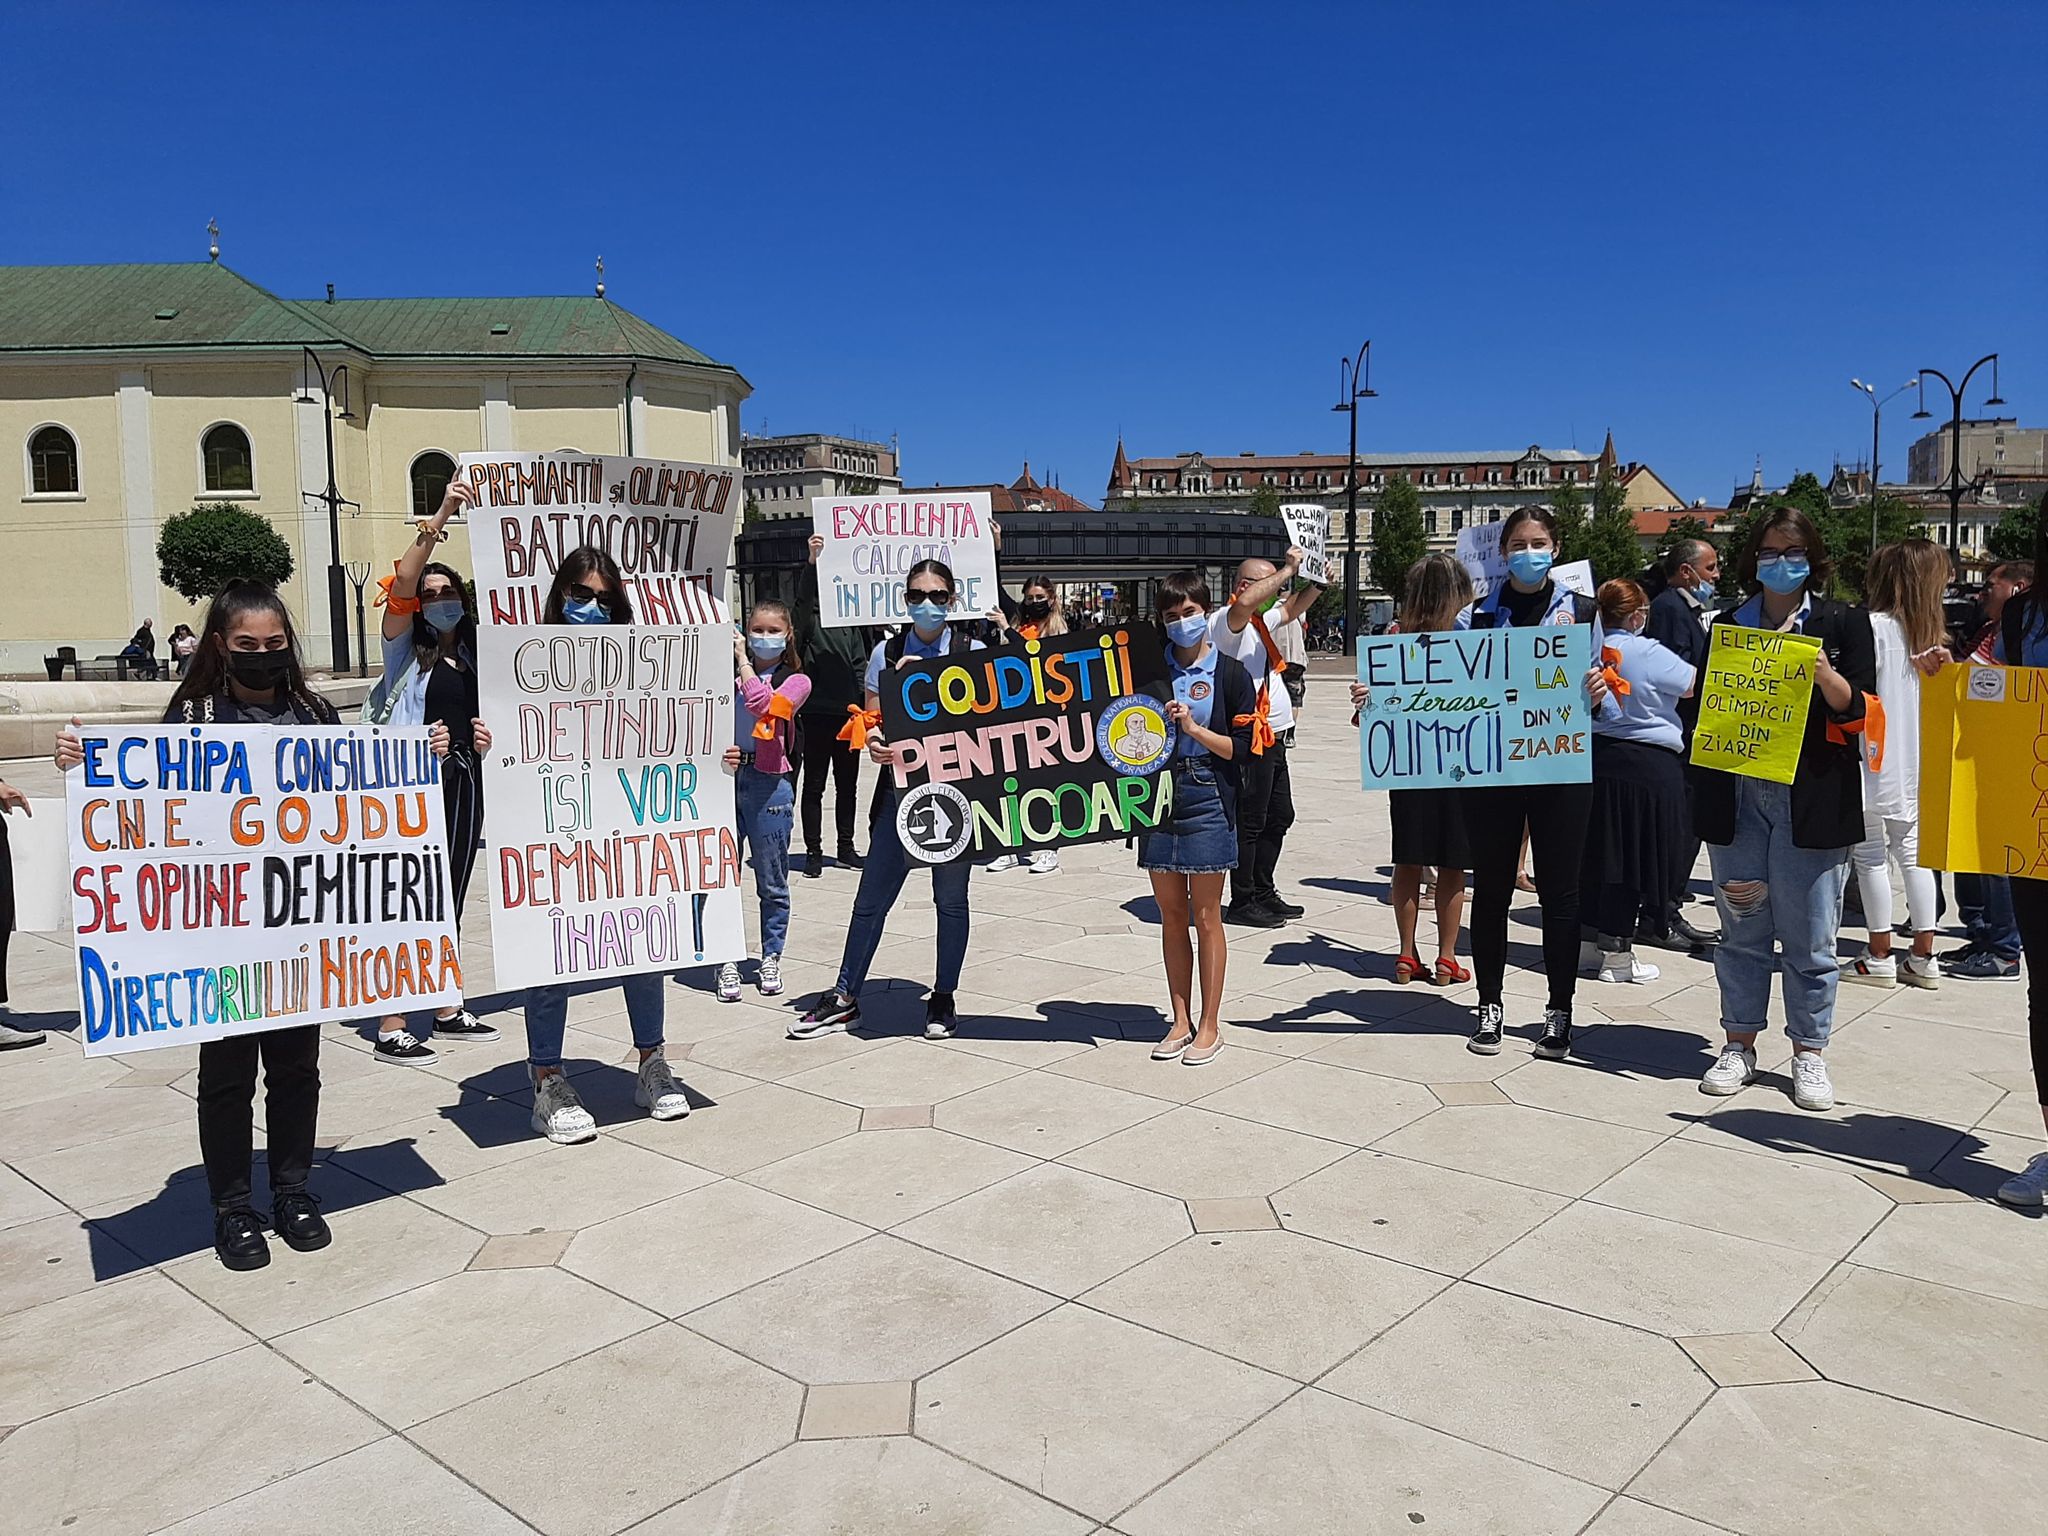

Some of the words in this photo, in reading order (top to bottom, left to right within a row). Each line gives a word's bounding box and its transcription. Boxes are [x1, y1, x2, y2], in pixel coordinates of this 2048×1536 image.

[629, 463, 733, 515] OLIMPICII
[832, 575, 860, 618] ÎN
[1534, 635, 1568, 659] DE
[1721, 630, 1784, 655] ELEVII
[1535, 665, 1569, 689] LA
[1711, 670, 1780, 696] TERASE
[1752, 657, 1777, 676] DE
[1784, 663, 1807, 681] LA
[1403, 687, 1500, 713] terase
[1706, 693, 1794, 723] OLIMPICII
[1523, 709, 1551, 728] DIN
[1740, 722, 1770, 743] DIN
[82, 727, 254, 794] ECHIPA
[275, 726, 439, 793] CONSILIULUI
[888, 712, 1095, 789] PENTRU
[1508, 732, 1585, 761] ZIARE
[1700, 733, 1761, 760] ZIARE
[618, 763, 699, 826] VOR
[231, 792, 430, 847] GOJDU
[971, 770, 1173, 850] NICOARA
[500, 826, 742, 909] DEMNITATEA
[73, 864, 127, 934] SE
[137, 862, 251, 931] OPUNE
[263, 843, 445, 928] DEMITERII
[320, 934, 463, 1009] NICOARA
